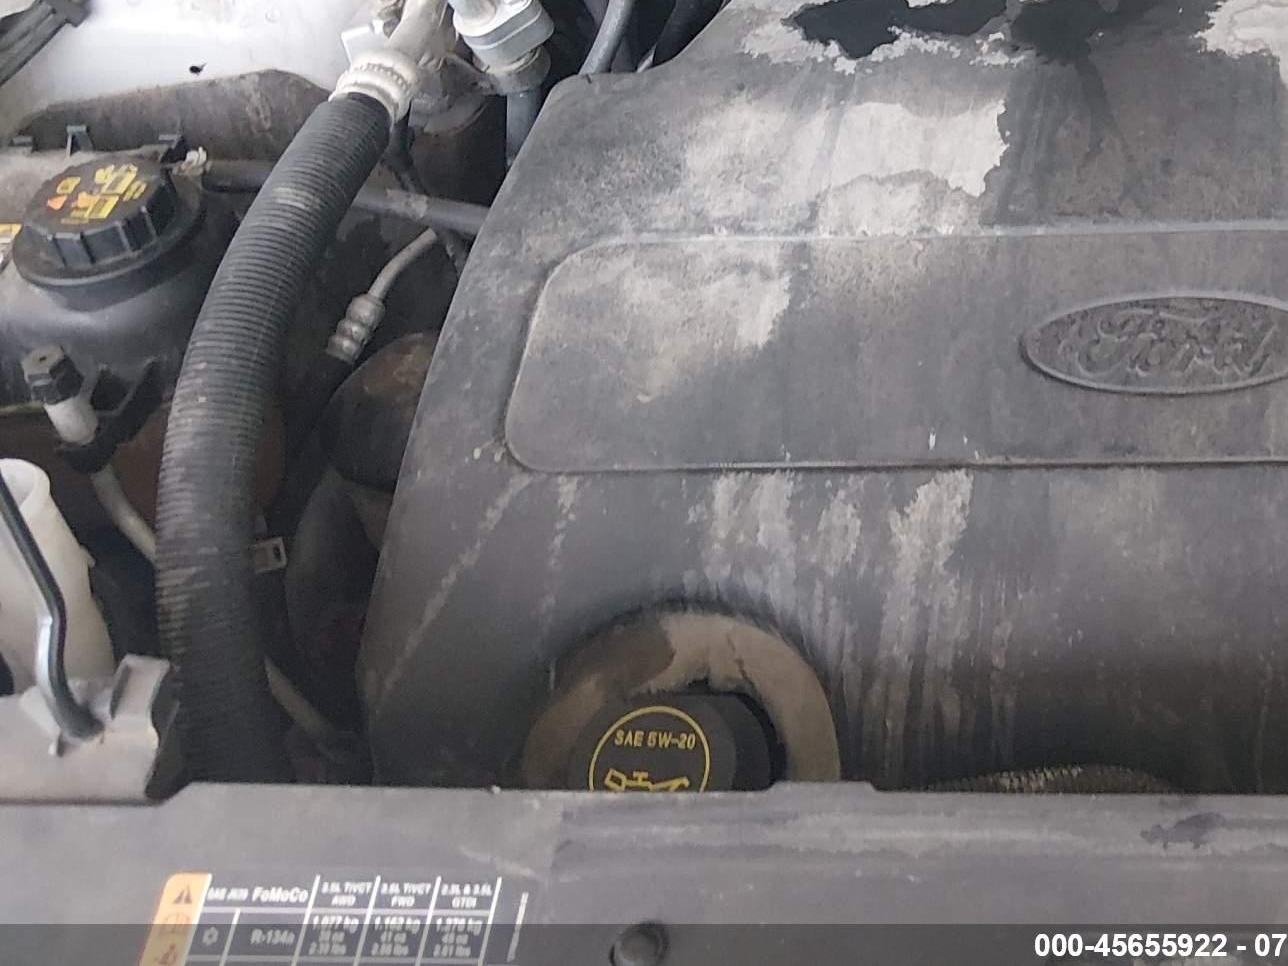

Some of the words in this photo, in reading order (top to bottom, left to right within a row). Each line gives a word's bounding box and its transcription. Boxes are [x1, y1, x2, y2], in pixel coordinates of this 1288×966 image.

[614, 729, 643, 747] SAE
[647, 731, 697, 750] 5W-20
[251, 886, 310, 903] FoMoCo
[331, 894, 357, 907] AWD
[390, 895, 416, 907] FWD
[343, 915, 360, 934] kg
[405, 916, 421, 934] kg
[466, 918, 483, 936] kg
